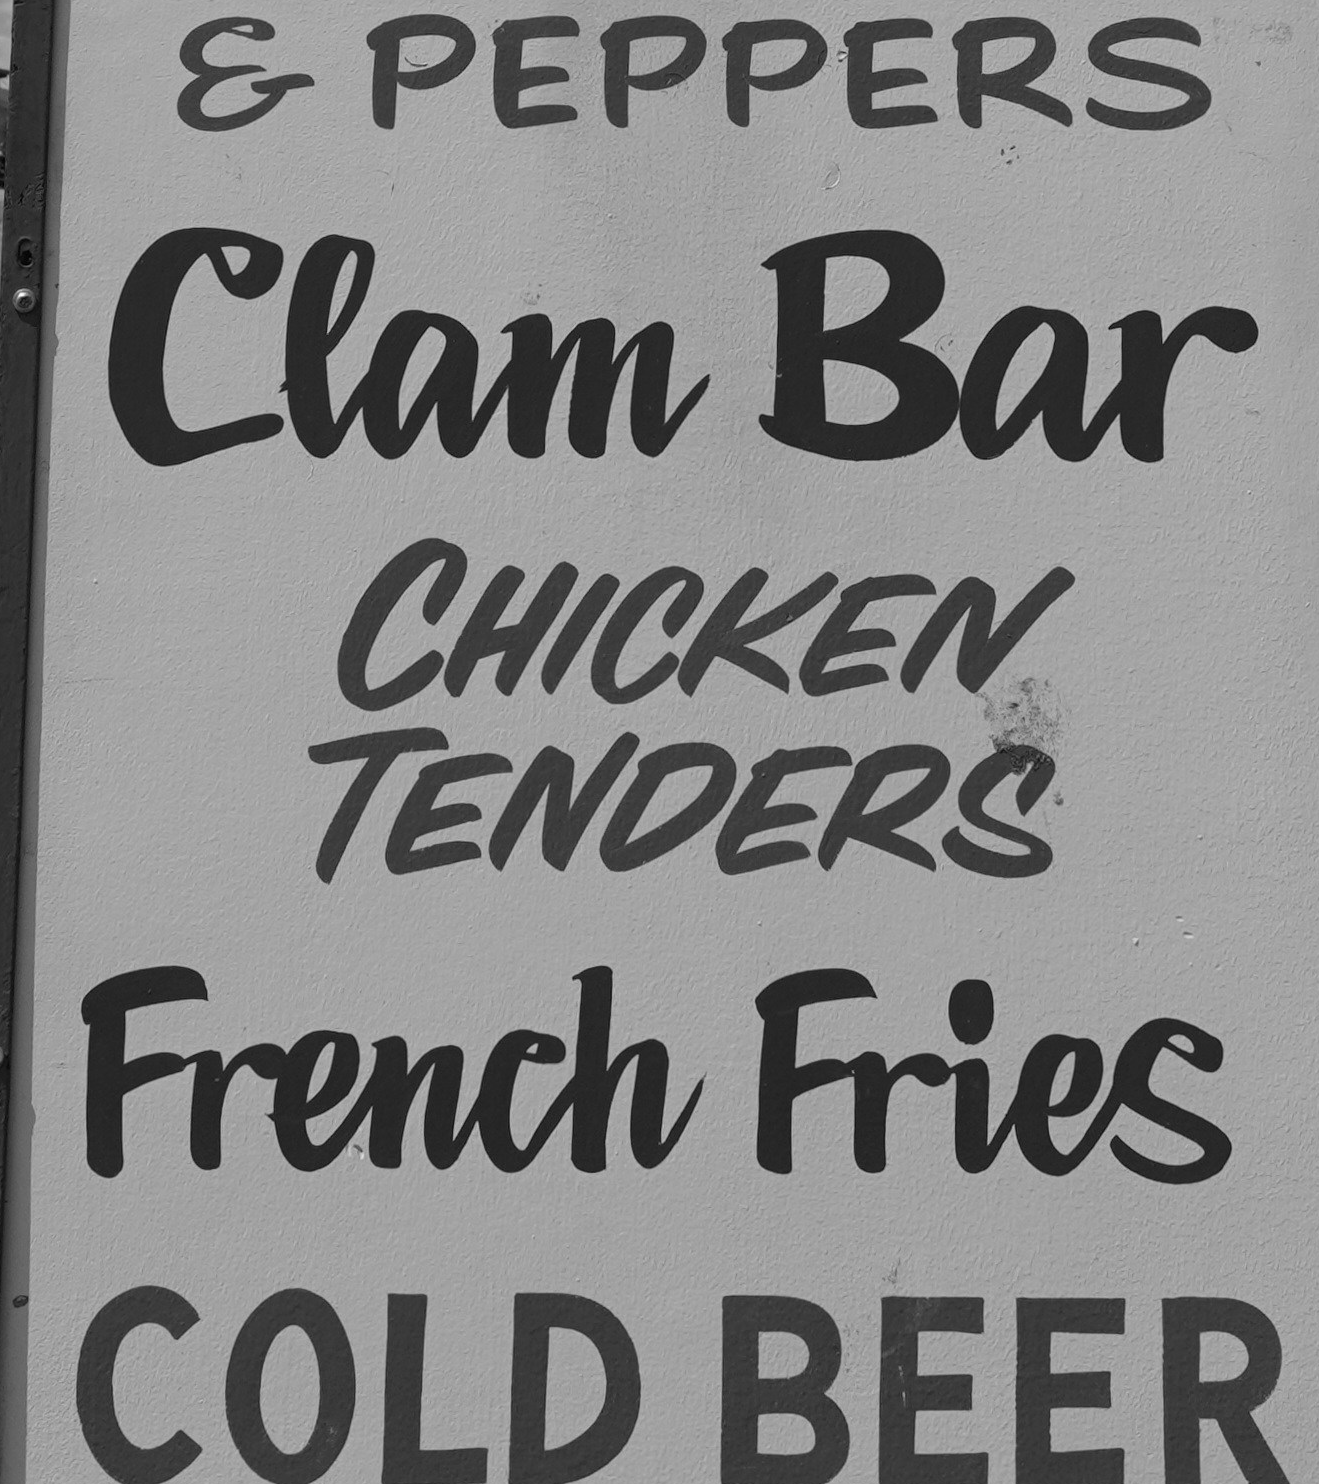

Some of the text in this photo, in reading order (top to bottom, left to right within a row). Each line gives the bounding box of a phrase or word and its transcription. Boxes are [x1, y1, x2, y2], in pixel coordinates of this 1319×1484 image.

[176, 13, 1212, 132] & PEPPERS
[107, 227, 1259, 467] Clam Bar
[337, 537, 1076, 712] CHICKEN
[307, 727, 1056, 885] TENDERS
[80, 965, 1233, 1185] French Fries
